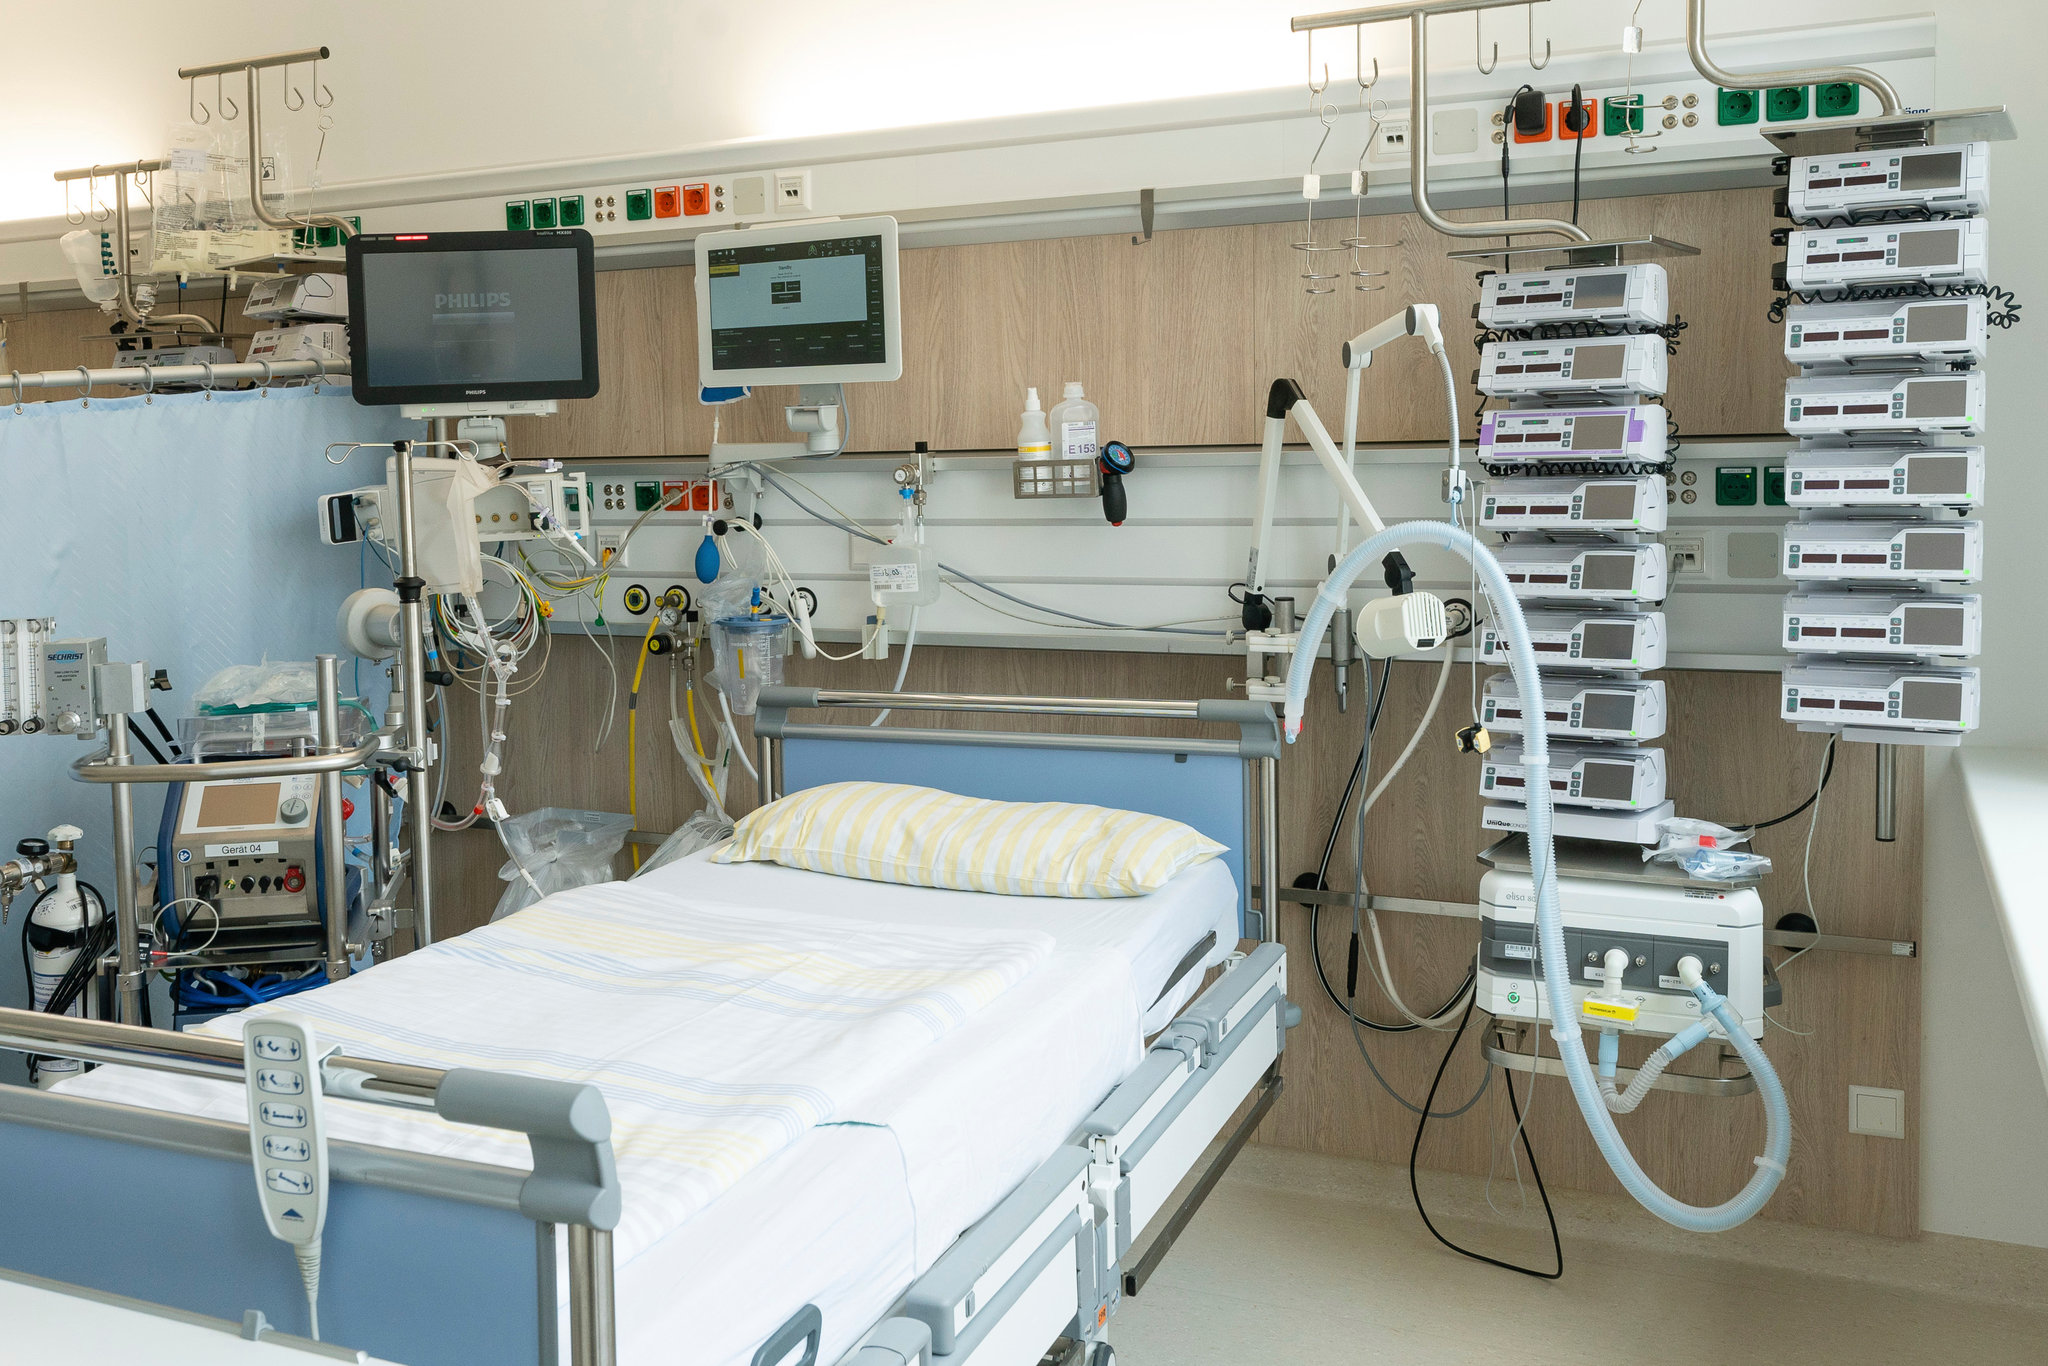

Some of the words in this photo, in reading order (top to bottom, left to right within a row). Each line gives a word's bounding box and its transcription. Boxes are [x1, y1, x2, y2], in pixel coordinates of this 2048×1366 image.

[435, 292, 511, 309] PHILIPS
[1068, 445, 1076, 455] E
[1078, 443, 1096, 454] 153
[47, 652, 85, 661] SECHRIST
[221, 844, 247, 855] Gerät
[249, 843, 262, 853] 04
[1505, 891, 1526, 901] elisa
